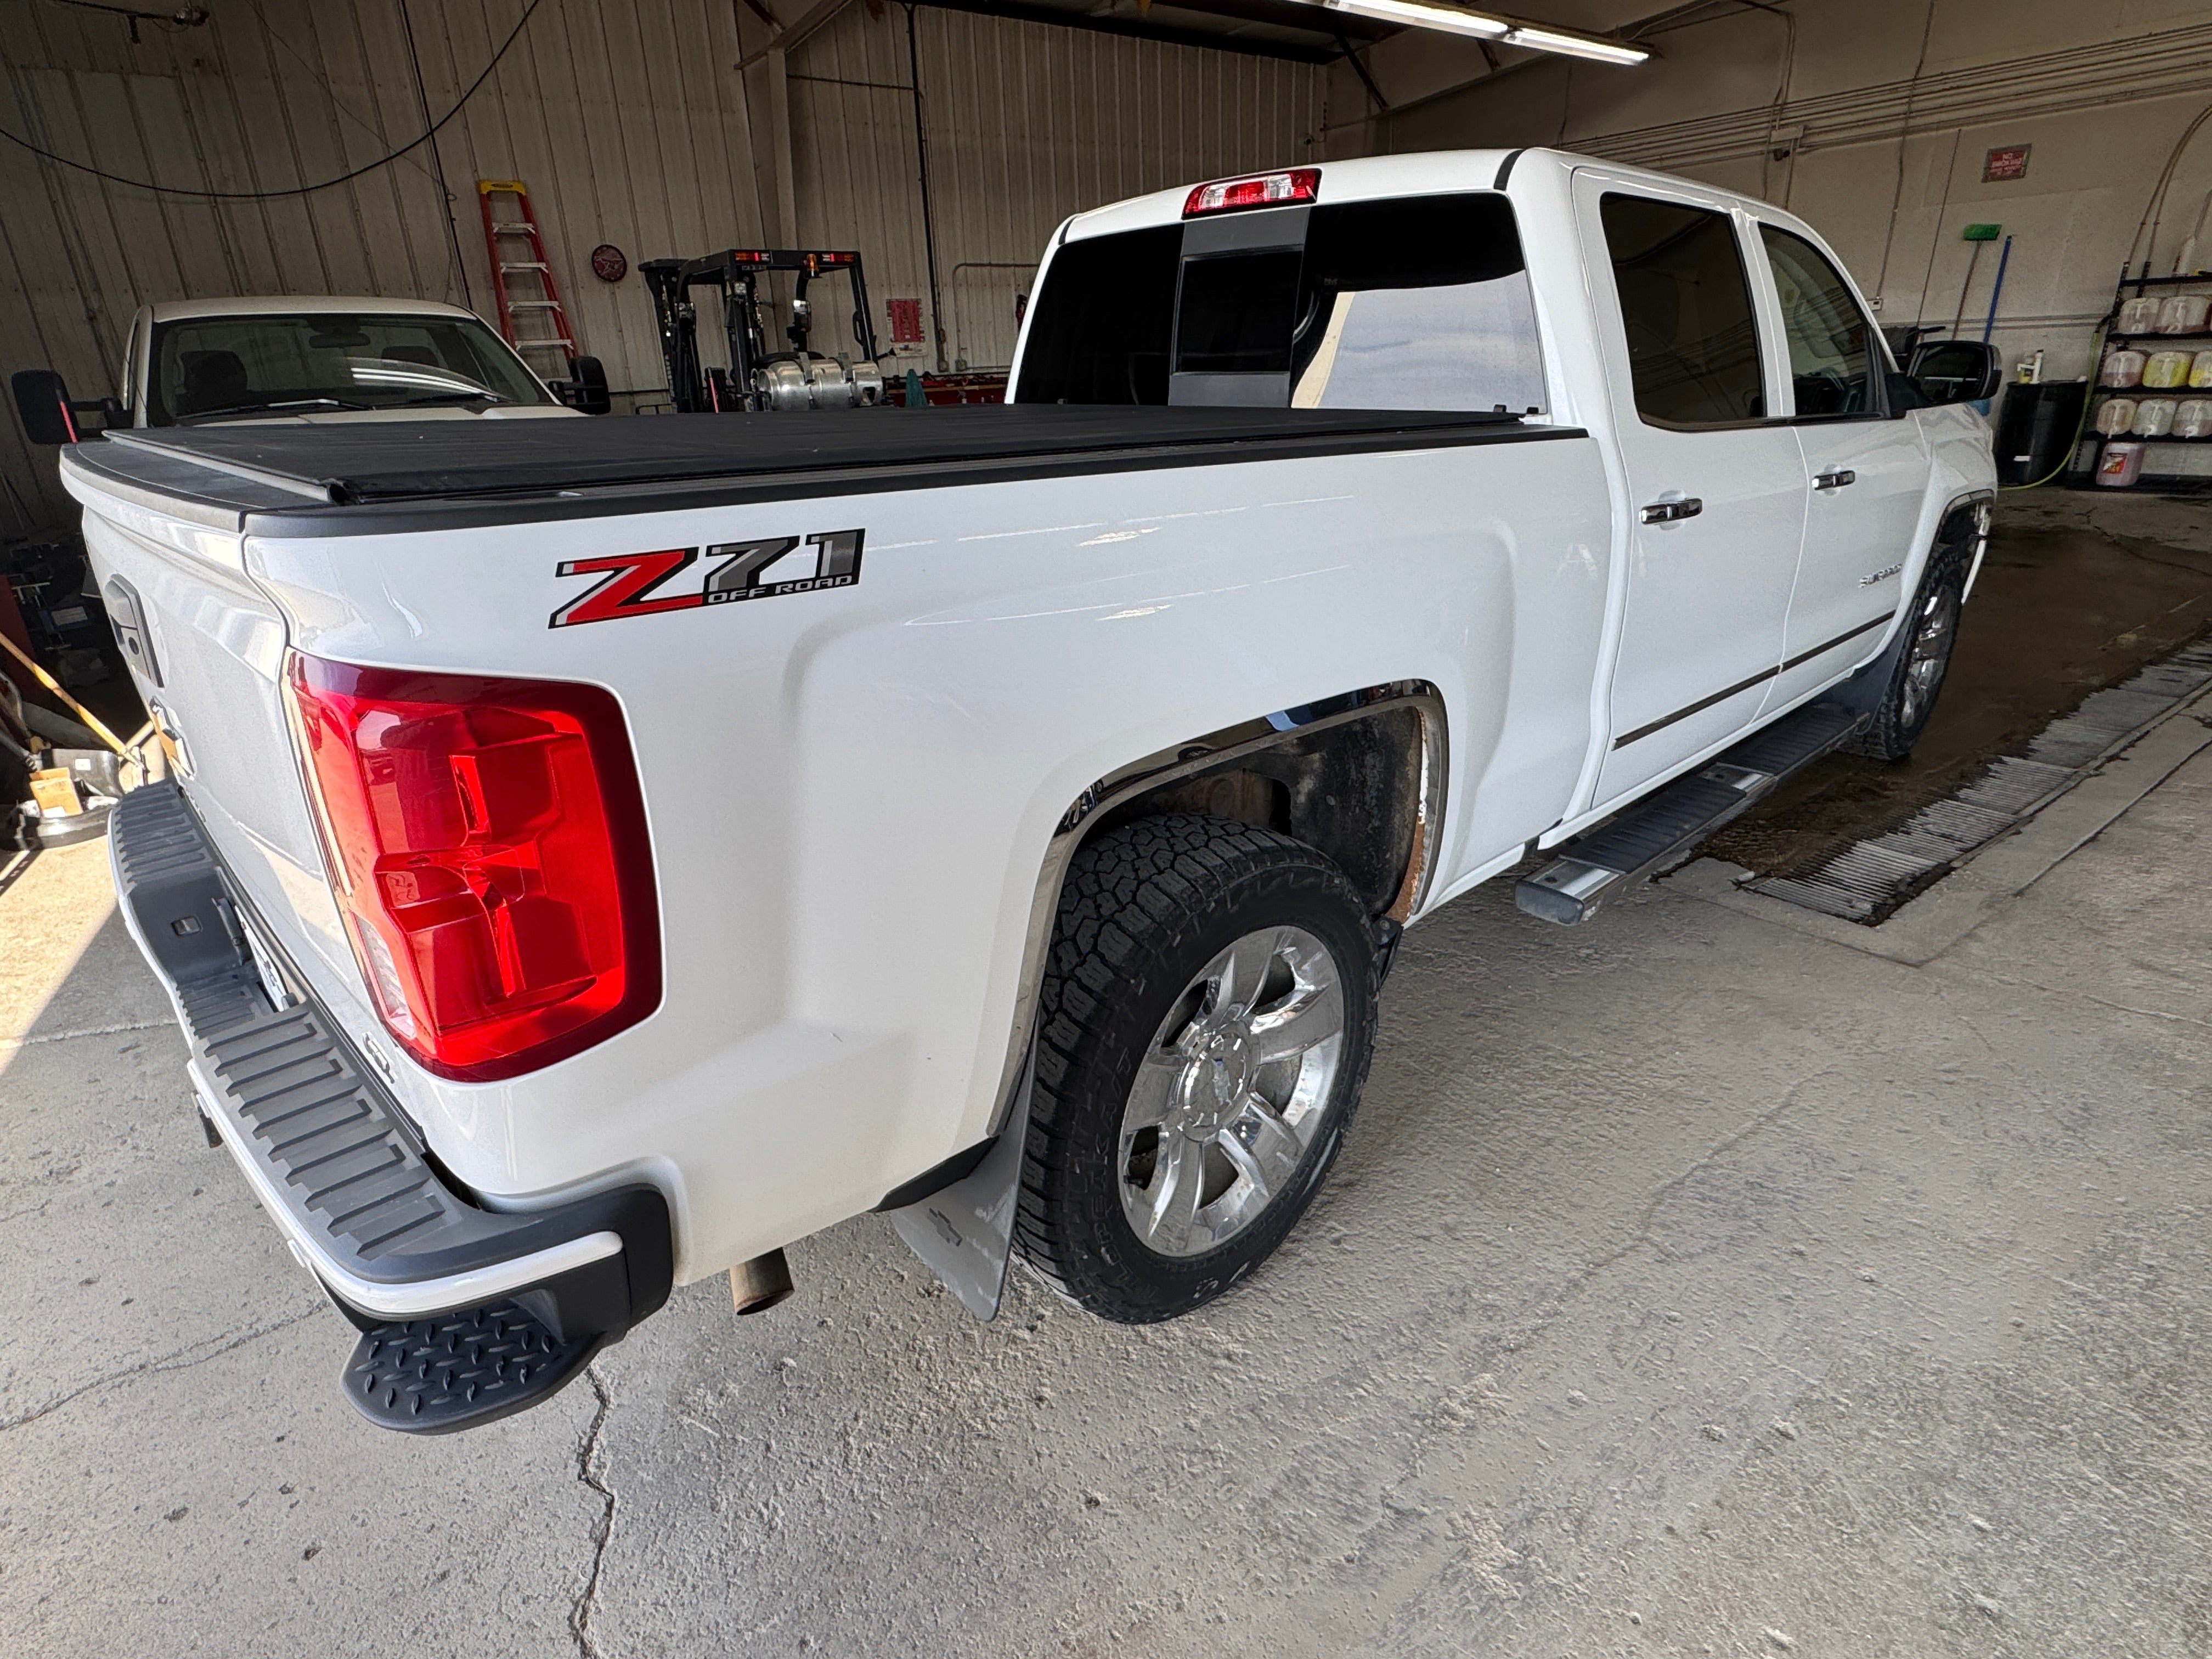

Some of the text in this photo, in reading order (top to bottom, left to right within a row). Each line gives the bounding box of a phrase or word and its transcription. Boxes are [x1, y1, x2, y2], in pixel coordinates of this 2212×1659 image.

[549, 528, 865, 629] Z71
[708, 575, 853, 603] OFF ROAD
